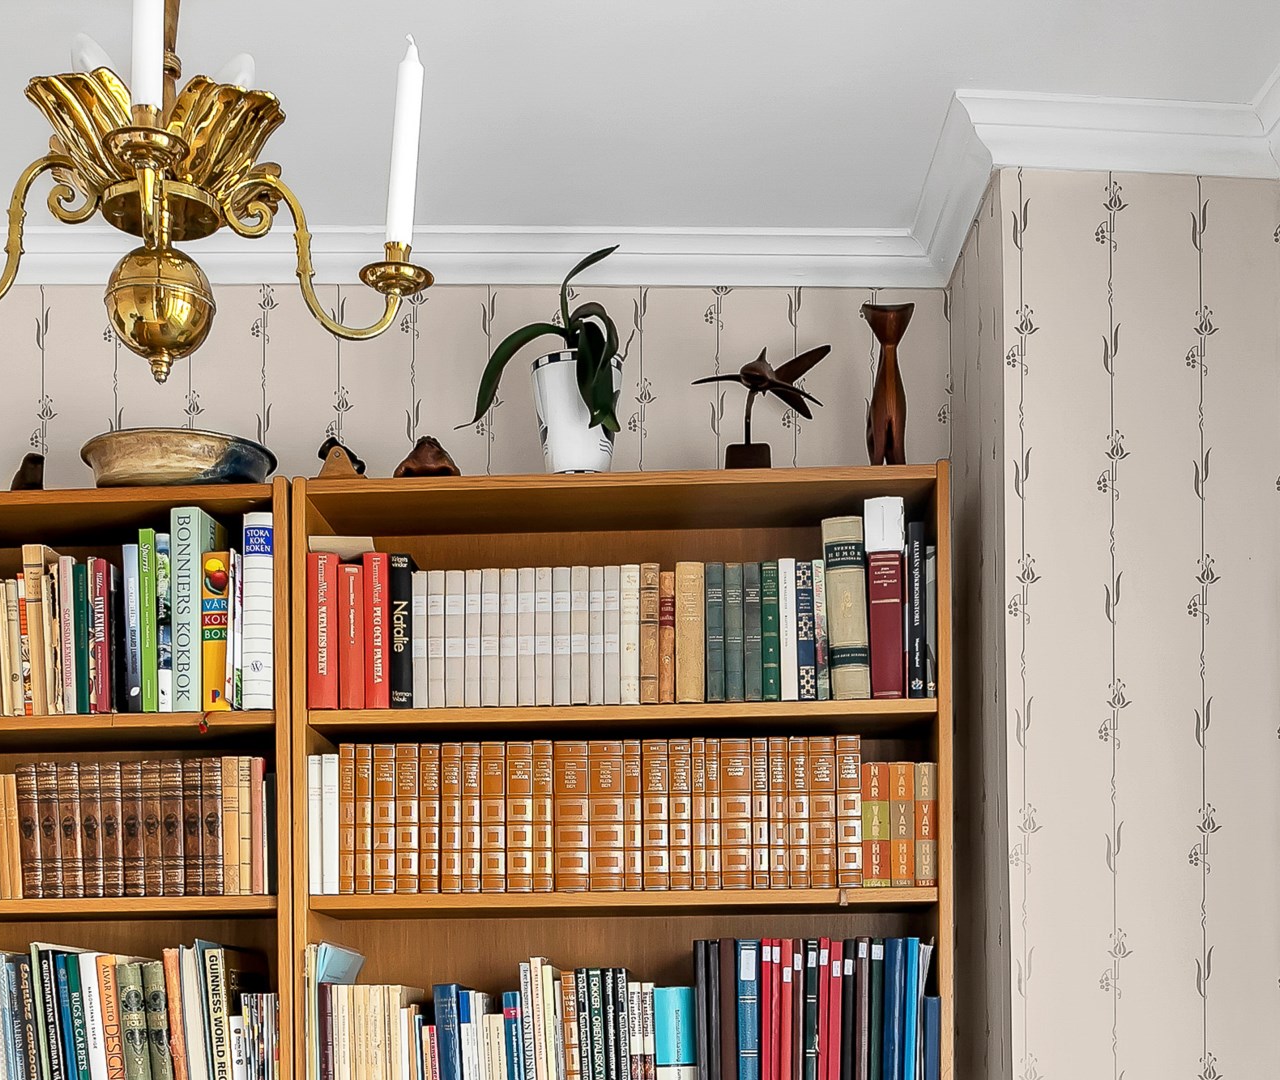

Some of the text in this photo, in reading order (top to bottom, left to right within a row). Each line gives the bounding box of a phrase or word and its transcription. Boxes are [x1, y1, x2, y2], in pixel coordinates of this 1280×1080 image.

[246, 529, 270, 537] STORA
[249, 537, 267, 545] KOK
[140, 543, 153, 572] Sparris
[245, 545, 271, 553] BOKEN
[913, 540, 921, 567] ALLMÄN
[176, 514, 191, 702] BONNIERS KOKBOK
[204, 599, 228, 610] VÅR
[204, 613, 227, 624] KOK
[204, 629, 227, 640] BOK
[393, 600, 410, 653] Natalie
[63, 608, 73, 688] SCARSDALEMETODEN
[373, 606, 383, 683] PUG OCH PAMELA
[898, 804, 906, 835] VAR
[872, 844, 880, 875] HUR
[899, 844, 907, 875] HUR
[922, 844, 930, 875] HUR
[19, 963, 32, 1021] Esquire
[101, 963, 111, 991] ALVAR
[208, 955, 222, 1014] GUINNESS
[577, 973, 587, 1003] Fokker
[591, 976, 600, 1009] FOKKER
[41, 959, 58, 1070] ORIENTMATTANS UNDERBARA
[104, 993, 115, 1022] AALTO
[71, 991, 87, 1070] RUGS & CARPETS
[213, 1016, 225, 1058] WORLD
[579, 1011, 590, 1057] Kaukasiska
[592, 1016, 604, 1073] ORIENTALISKA
[618, 1011, 629, 1056] Kaukasiska
[25, 1023, 37, 1080] cartoon
